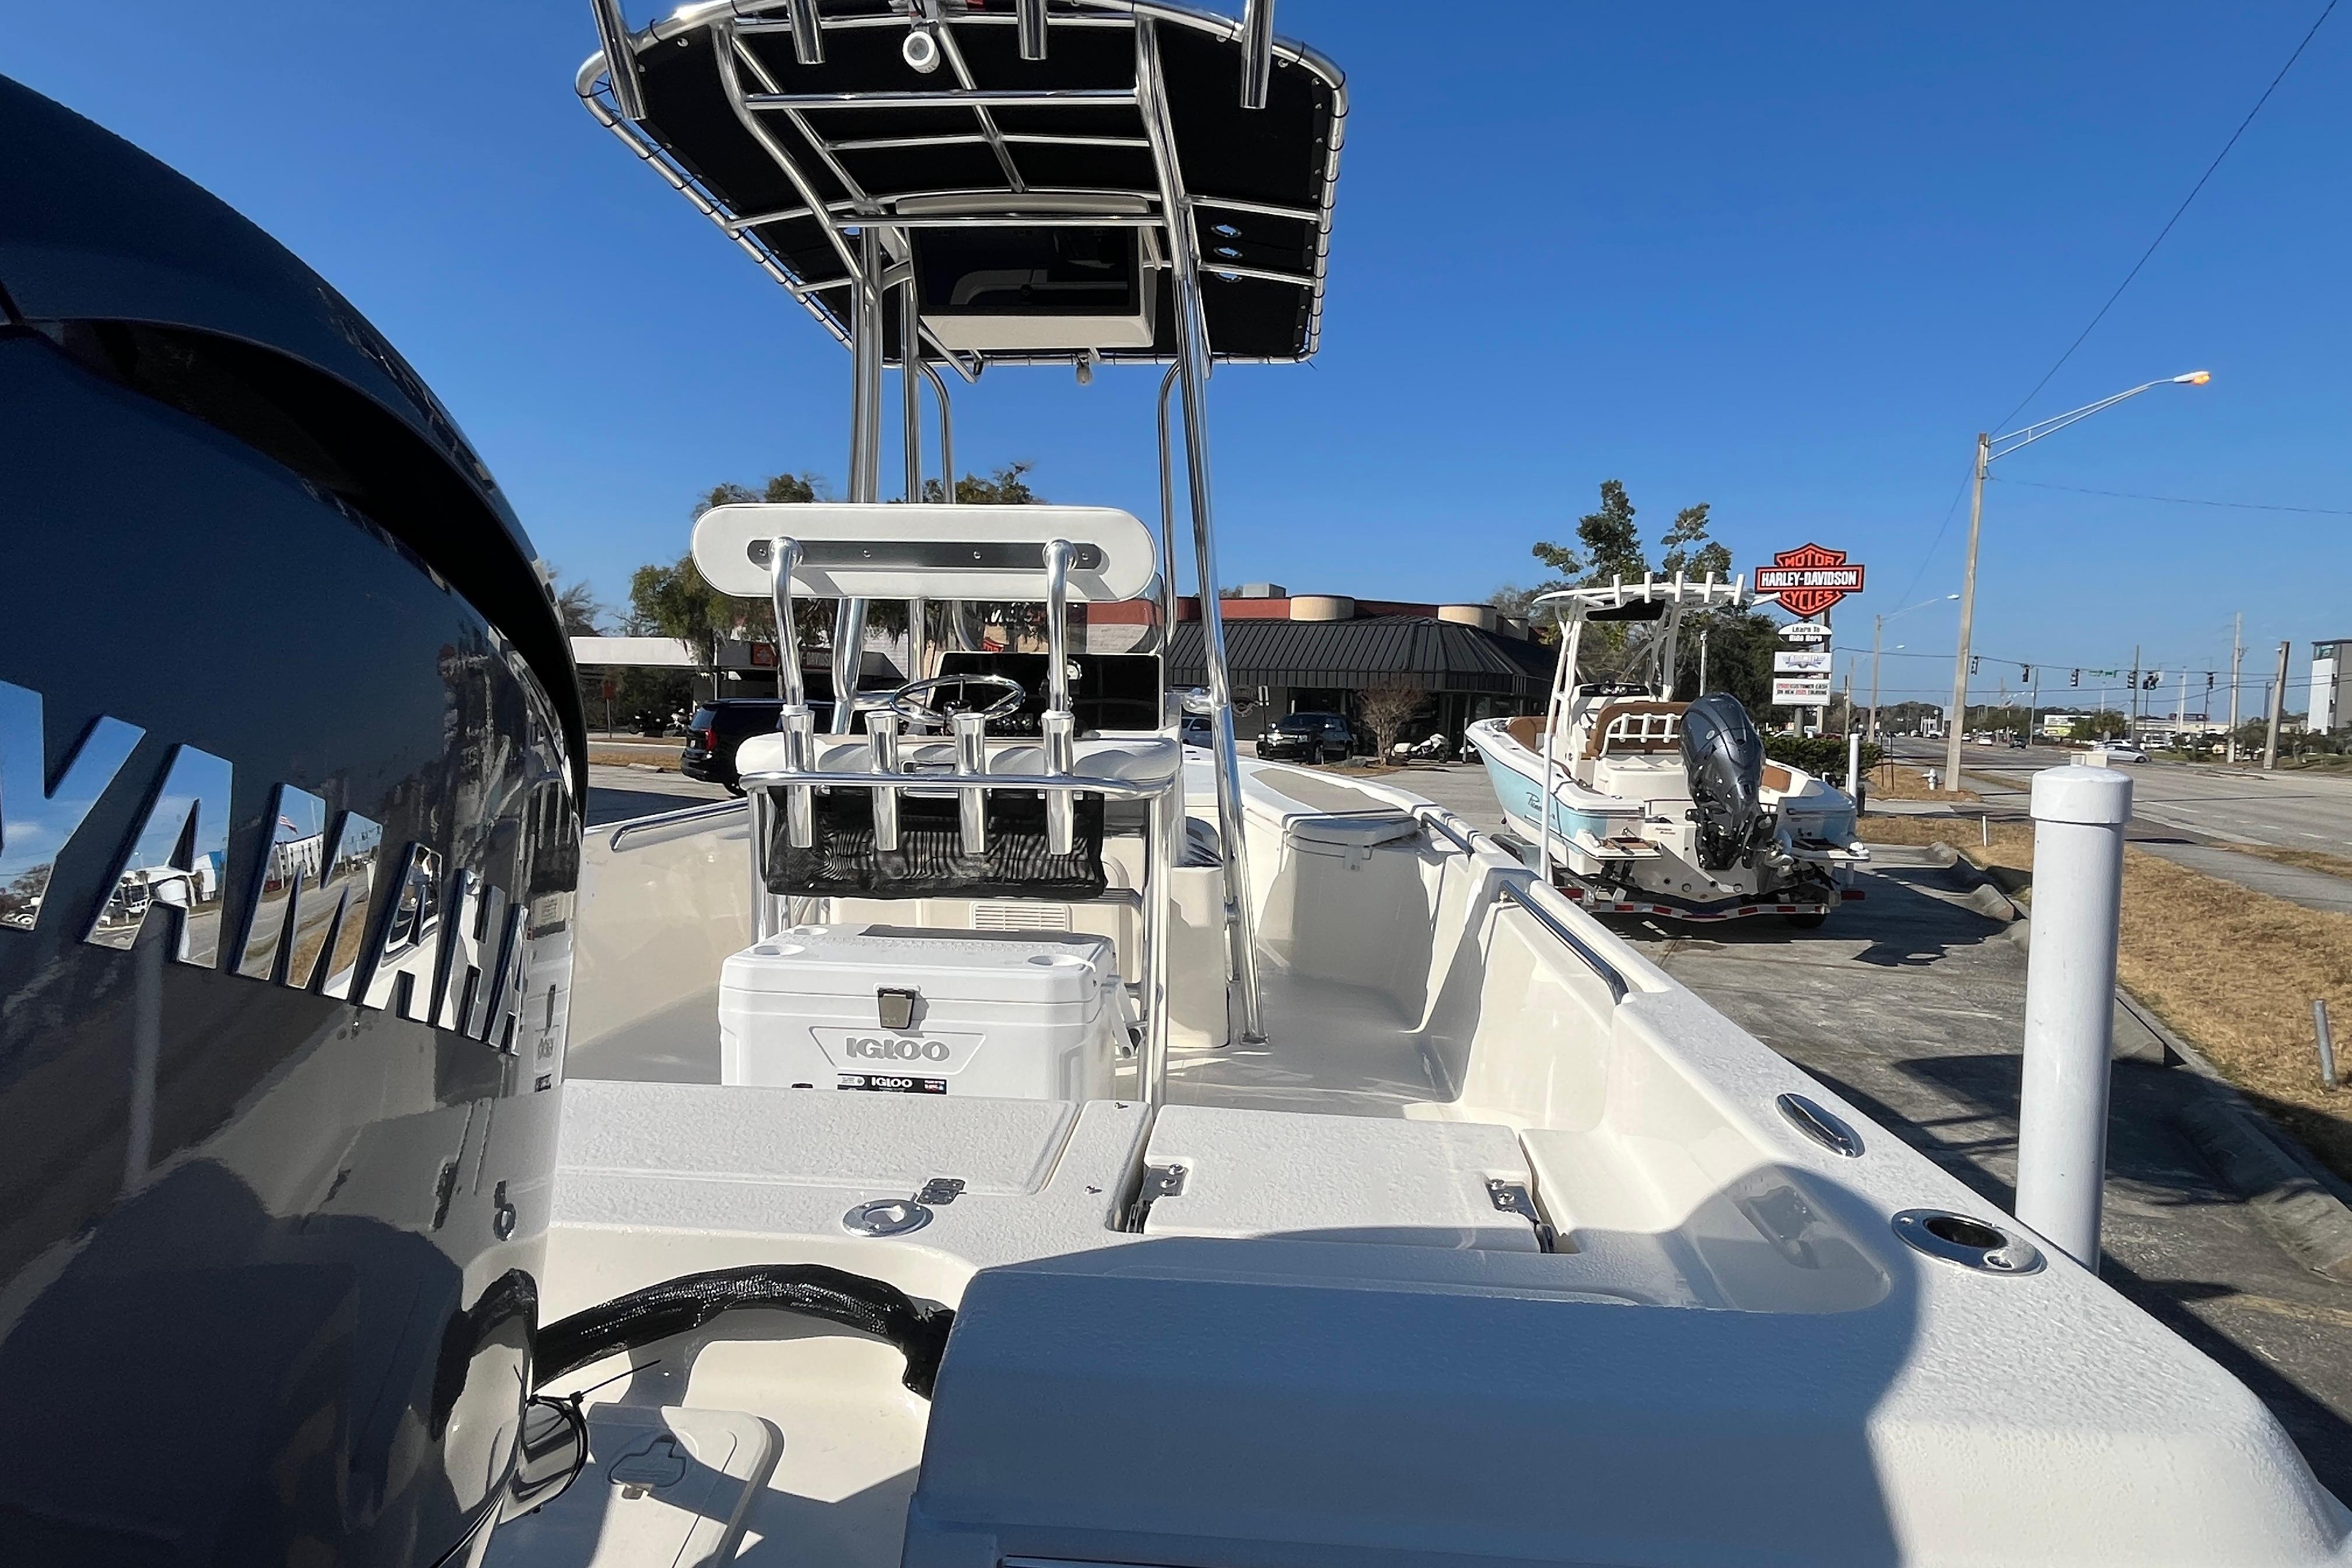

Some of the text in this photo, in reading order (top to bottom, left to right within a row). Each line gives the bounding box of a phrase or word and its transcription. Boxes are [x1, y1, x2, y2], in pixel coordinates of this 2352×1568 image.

[1785, 550, 1835, 566] MOTOR
[1761, 570, 1857, 587] HARLEY-DAVIDSON
[1782, 590, 1833, 610] CYCLES
[0, 680, 528, 1056] YAMAHA
[846, 1037, 950, 1062] IGLOO
[872, 1077, 913, 1088] IGLOO
